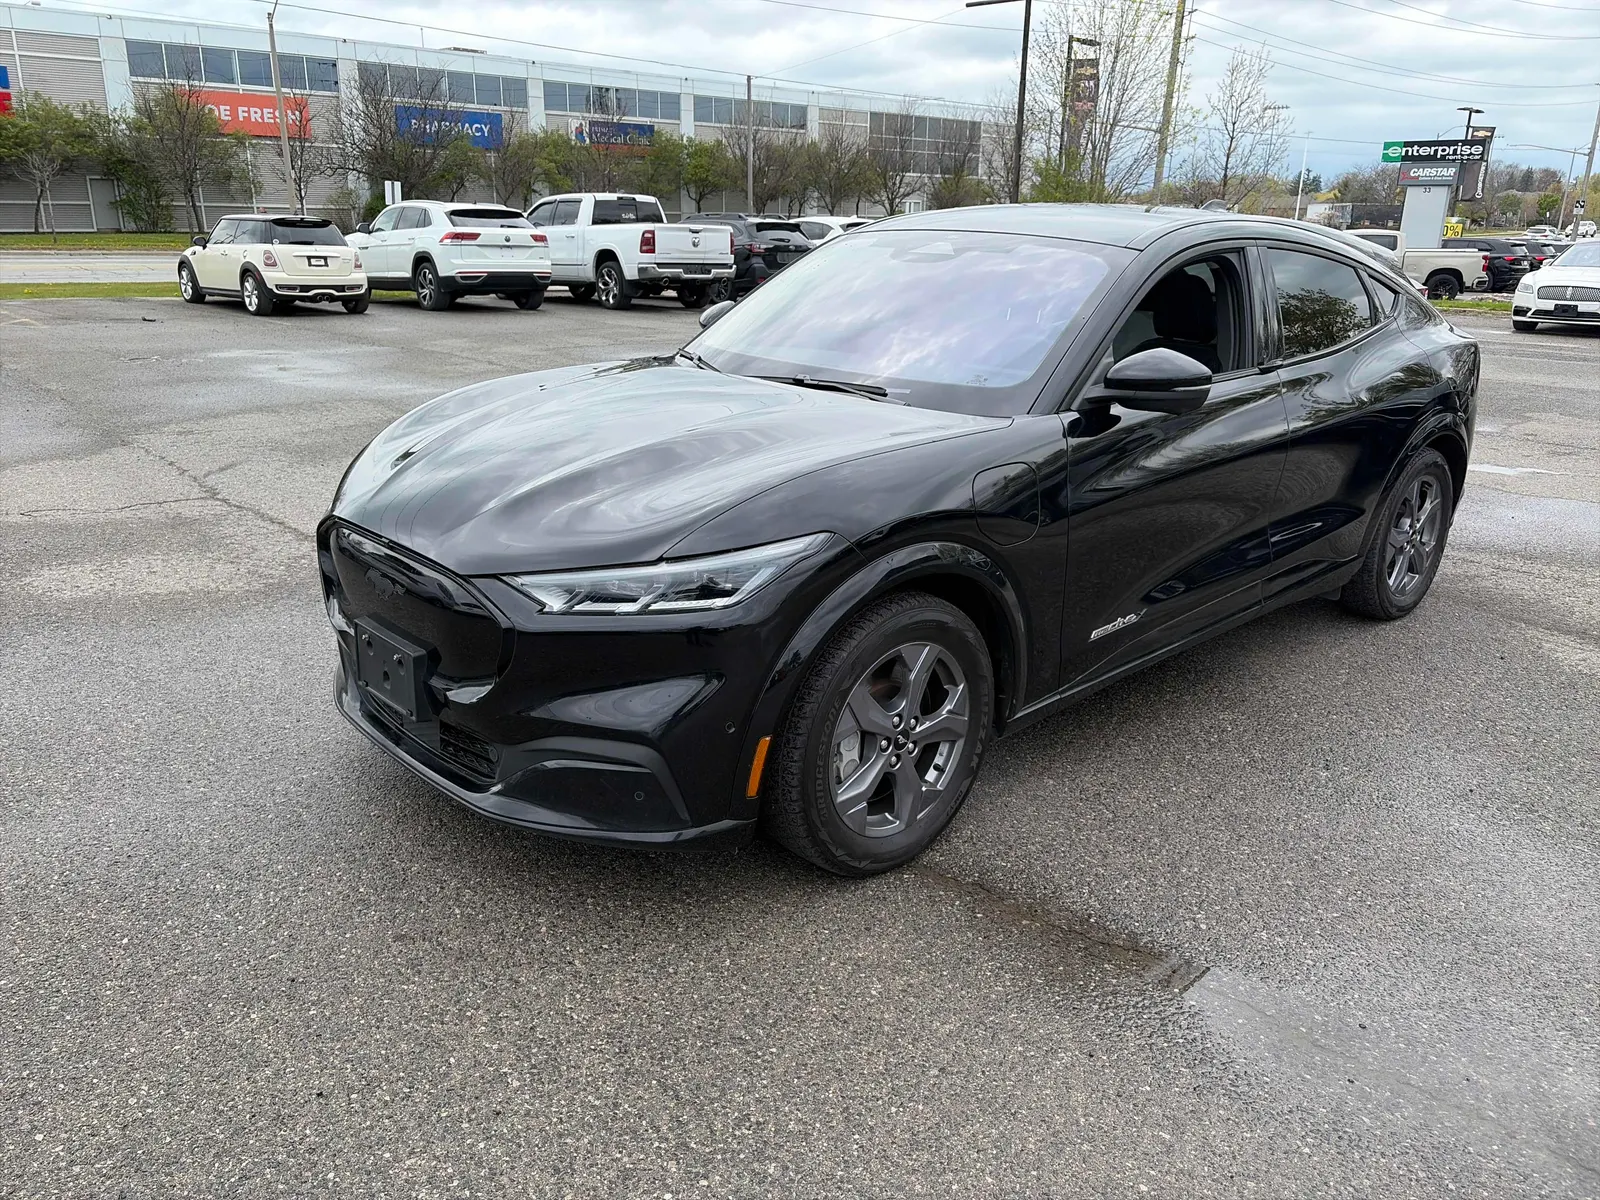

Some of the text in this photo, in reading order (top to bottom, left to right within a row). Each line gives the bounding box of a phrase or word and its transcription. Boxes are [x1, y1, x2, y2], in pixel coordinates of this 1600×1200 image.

[199, 104, 231, 121] OE
[591, 133, 624, 144] Medical
[1385, 143, 1483, 158] enterprise
[1410, 167, 1455, 177] CARSTAR
